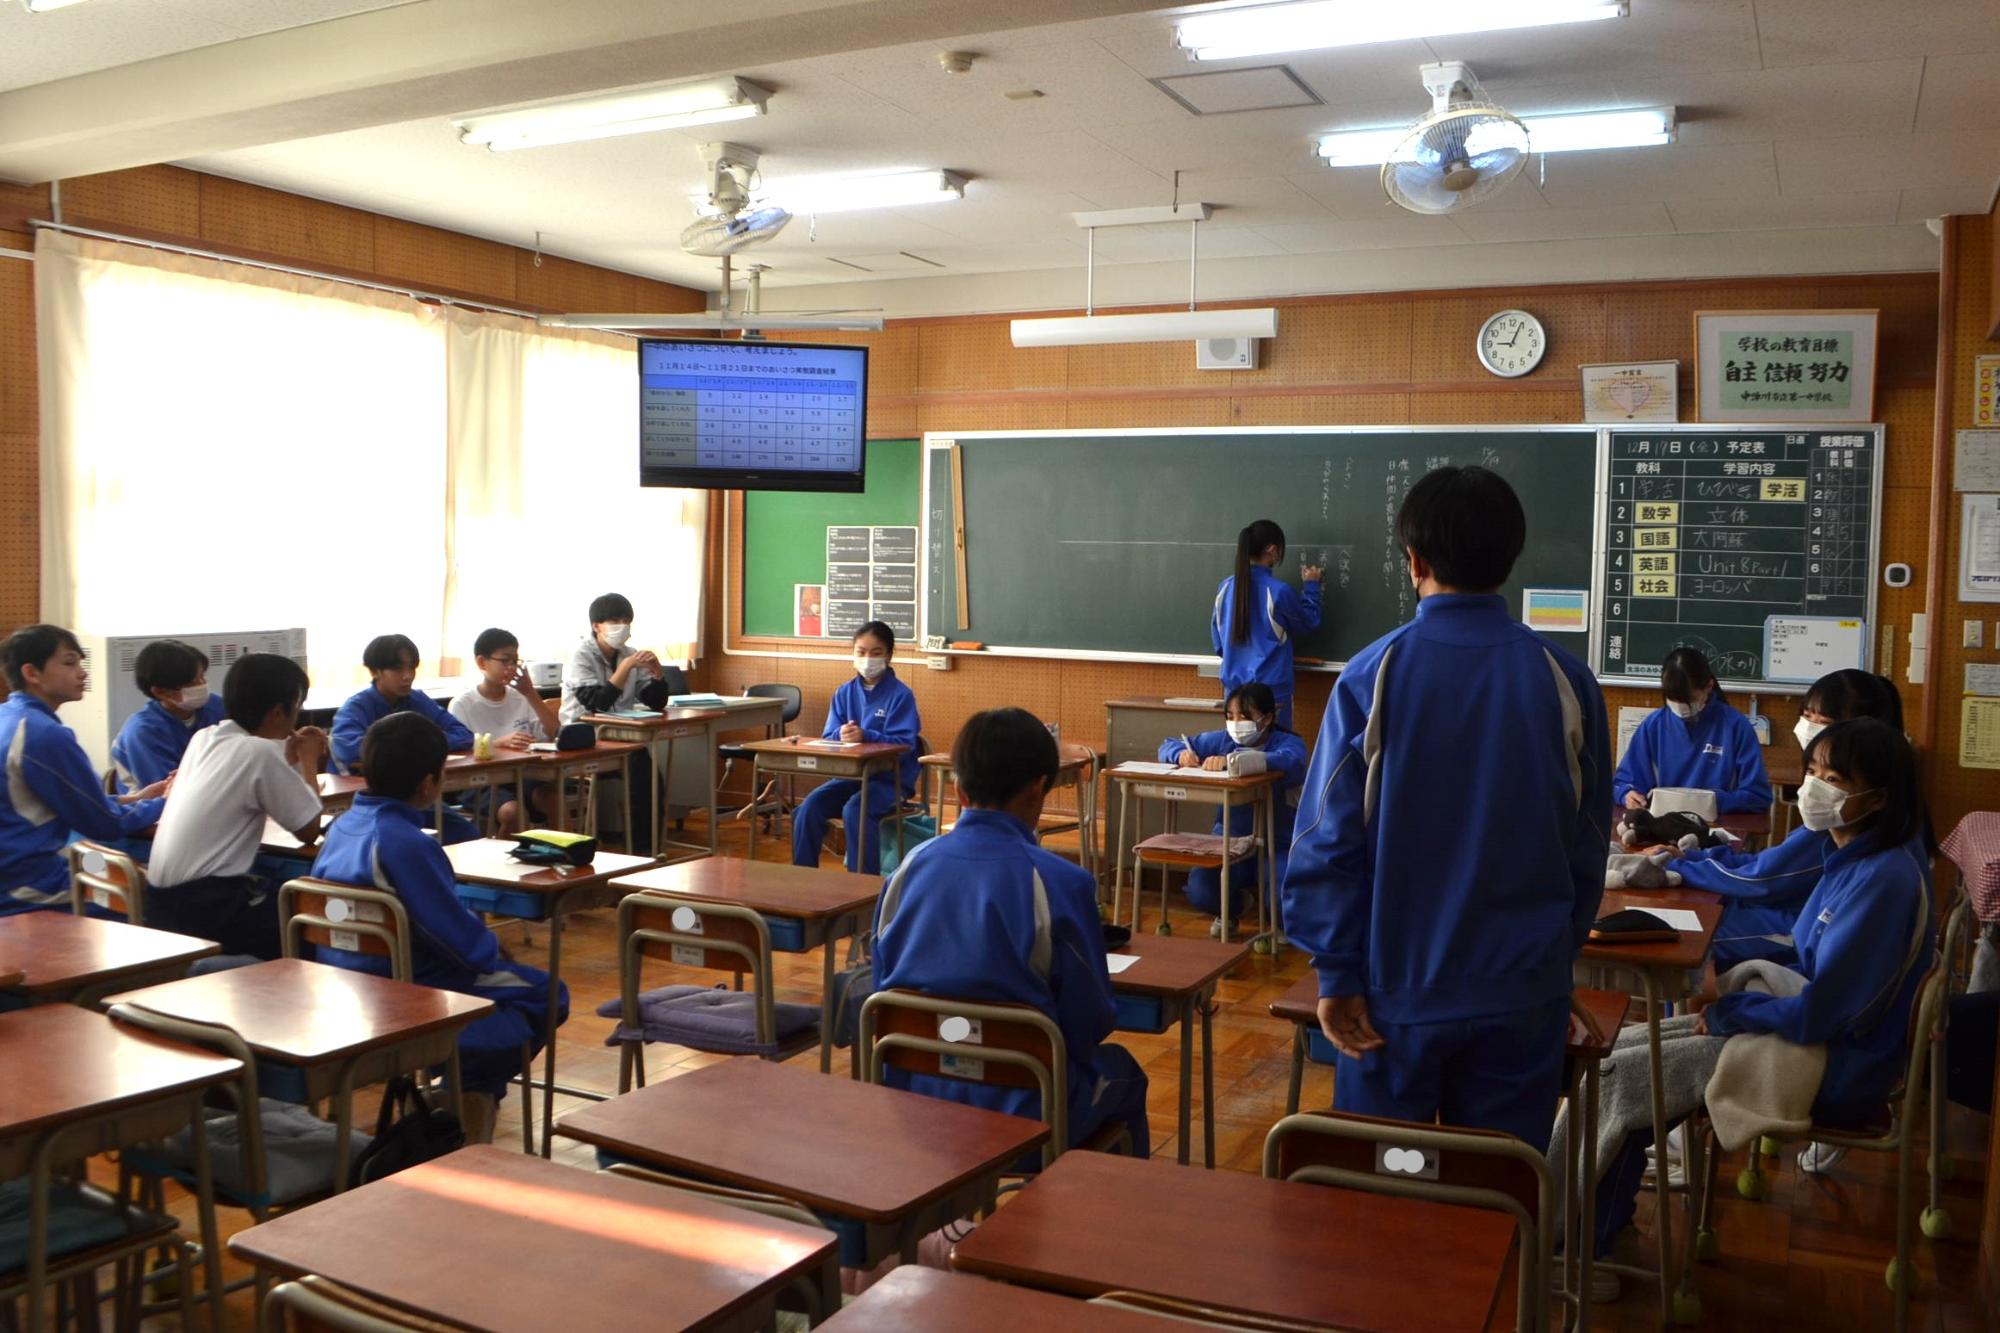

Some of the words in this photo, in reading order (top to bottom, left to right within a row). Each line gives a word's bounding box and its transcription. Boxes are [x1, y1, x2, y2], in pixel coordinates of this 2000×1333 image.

[1509, 319, 1516, 327] 12
[1738, 336, 1839, 352] 学校の教育目標
[1725, 360, 1757, 383] 自主
[1763, 361, 1803, 384] 信頼
[1807, 360, 1849, 384] 努力
[1726, 441, 1766, 455] 予定表
[1634, 462, 1661, 474] 教科
[1722, 462, 1776, 476] 学習内容
[1815, 471, 1822, 483] 1
[1618, 481, 1625, 496] 1
[1767, 482, 1799, 498] 学活
[1813, 489, 1824, 500] 2
[1616, 506, 1625, 520] 2
[1642, 506, 1671, 521] 数学
[1706, 505, 1750, 525] 立体
[1812, 507, 1823, 518] 3
[1615, 530, 1624, 544] 3
[1811, 526, 1822, 537] 4
[1641, 531, 1670, 547] 国語
[1811, 544, 1821, 556] 5
[1615, 555, 1623, 567] 4
[1639, 557, 1668, 572] 英語
[1698, 554, 1736, 575] Unit
[1810, 563, 1821, 574] 6
[1614, 579, 1623, 592] 5
[1639, 579, 1669, 594] 社会
[1612, 602, 1621, 616] 6
[1609, 635, 1623, 660] 連絡
